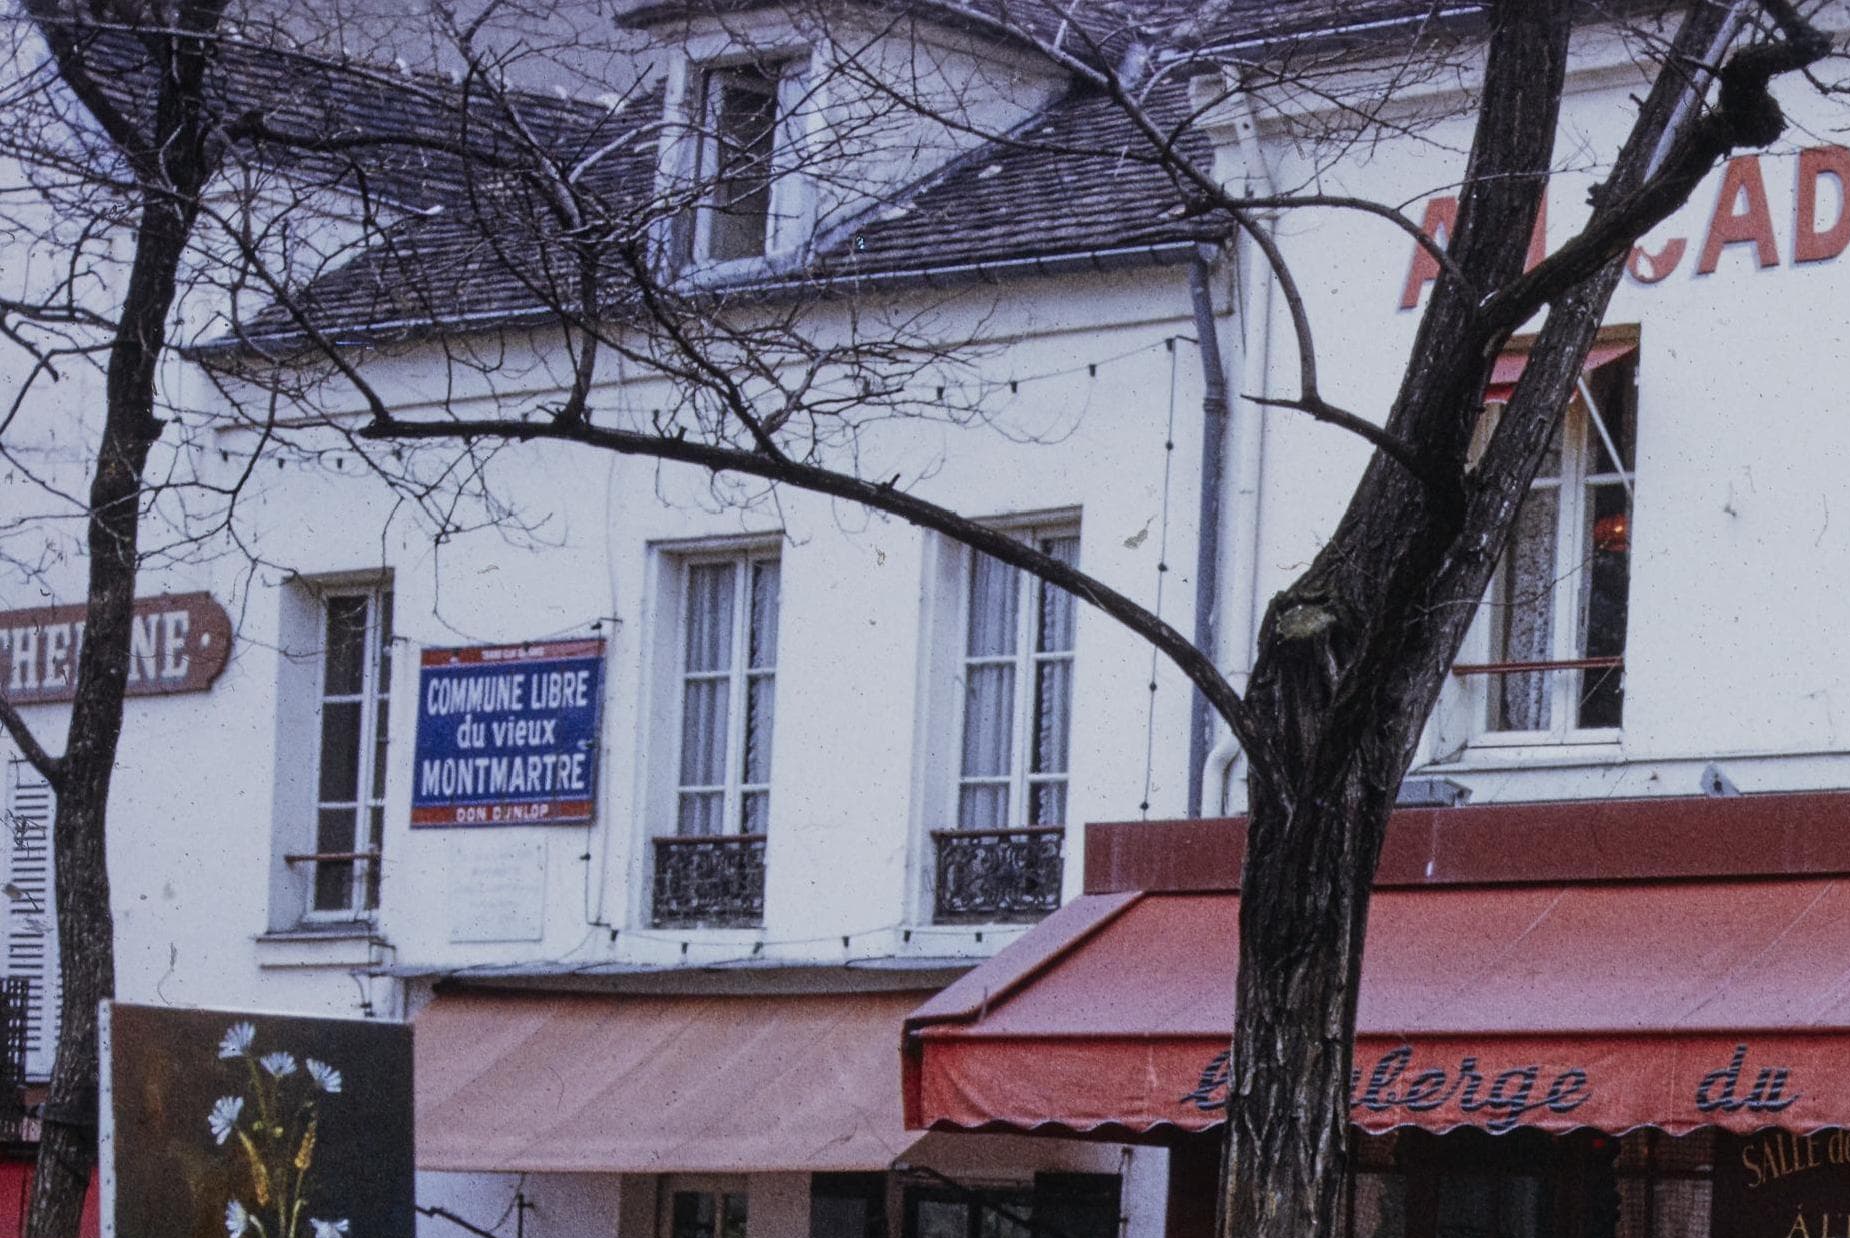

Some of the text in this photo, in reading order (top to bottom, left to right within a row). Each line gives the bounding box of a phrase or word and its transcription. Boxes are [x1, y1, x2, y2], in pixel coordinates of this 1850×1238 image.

[0, 610, 189, 690] HENE
[427, 670, 590, 716] COMMUNE LIBRE
[456, 714, 557, 749] du vieux
[421, 752, 586, 797] MONTMARTRE
[1696, 1044, 1798, 1113] du
[1741, 1133, 1821, 1188] SALLE
